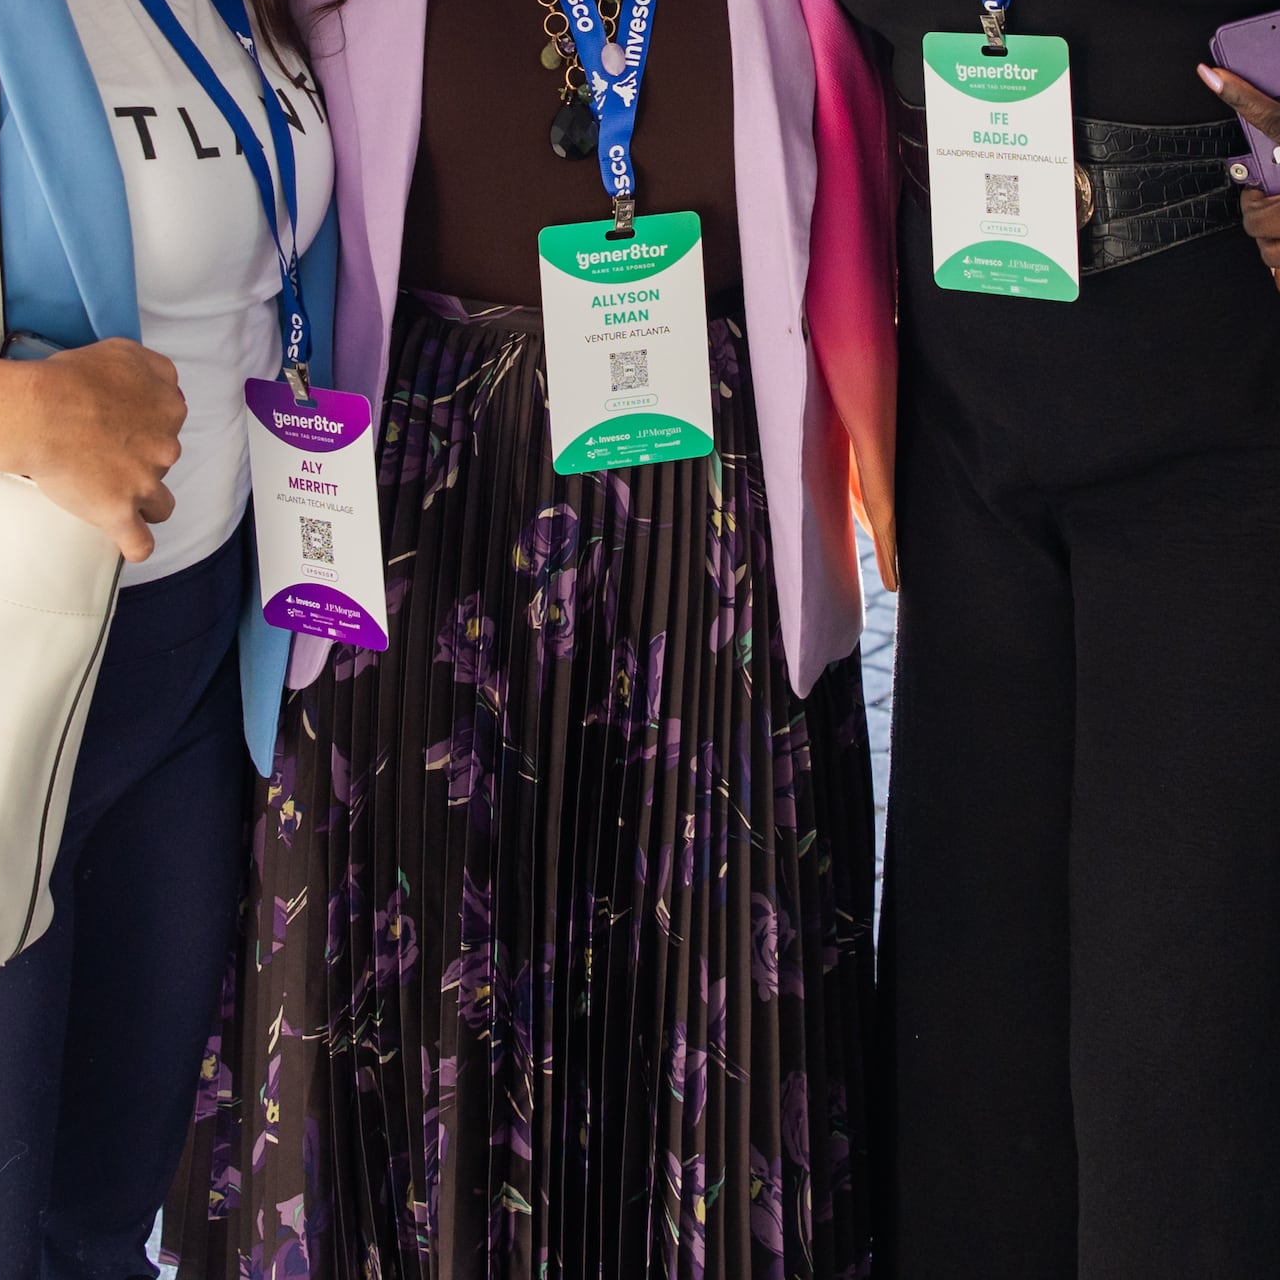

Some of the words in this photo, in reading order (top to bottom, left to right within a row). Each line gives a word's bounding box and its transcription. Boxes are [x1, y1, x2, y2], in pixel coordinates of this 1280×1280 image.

[956, 62, 1039, 82] gener8tor
[990, 112, 1009, 125] IFE
[973, 131, 1029, 147] BADEJO
[936, 148, 995, 160] ISLANDPRENEUR
[996, 151, 1053, 163] INTERNATIONAL
[1054, 156, 1068, 165] LLC
[576, 243, 669, 269] gener8tor
[591, 289, 660, 308] ALLYSON
[604, 309, 649, 326] EMAN
[584, 330, 627, 343] VENTURE
[629, 326, 671, 338] ATLANTA
[273, 408, 344, 435] gener8tor
[599, 434, 631, 444] Invesco
[301, 460, 322, 475] ALY
[288, 476, 338, 497] MERRITT
[276, 493, 306, 507] ATLANTA
[307, 498, 326, 510] TECH
[326, 502, 354, 515] VILLAGE
[296, 596, 320, 609] Invesco
